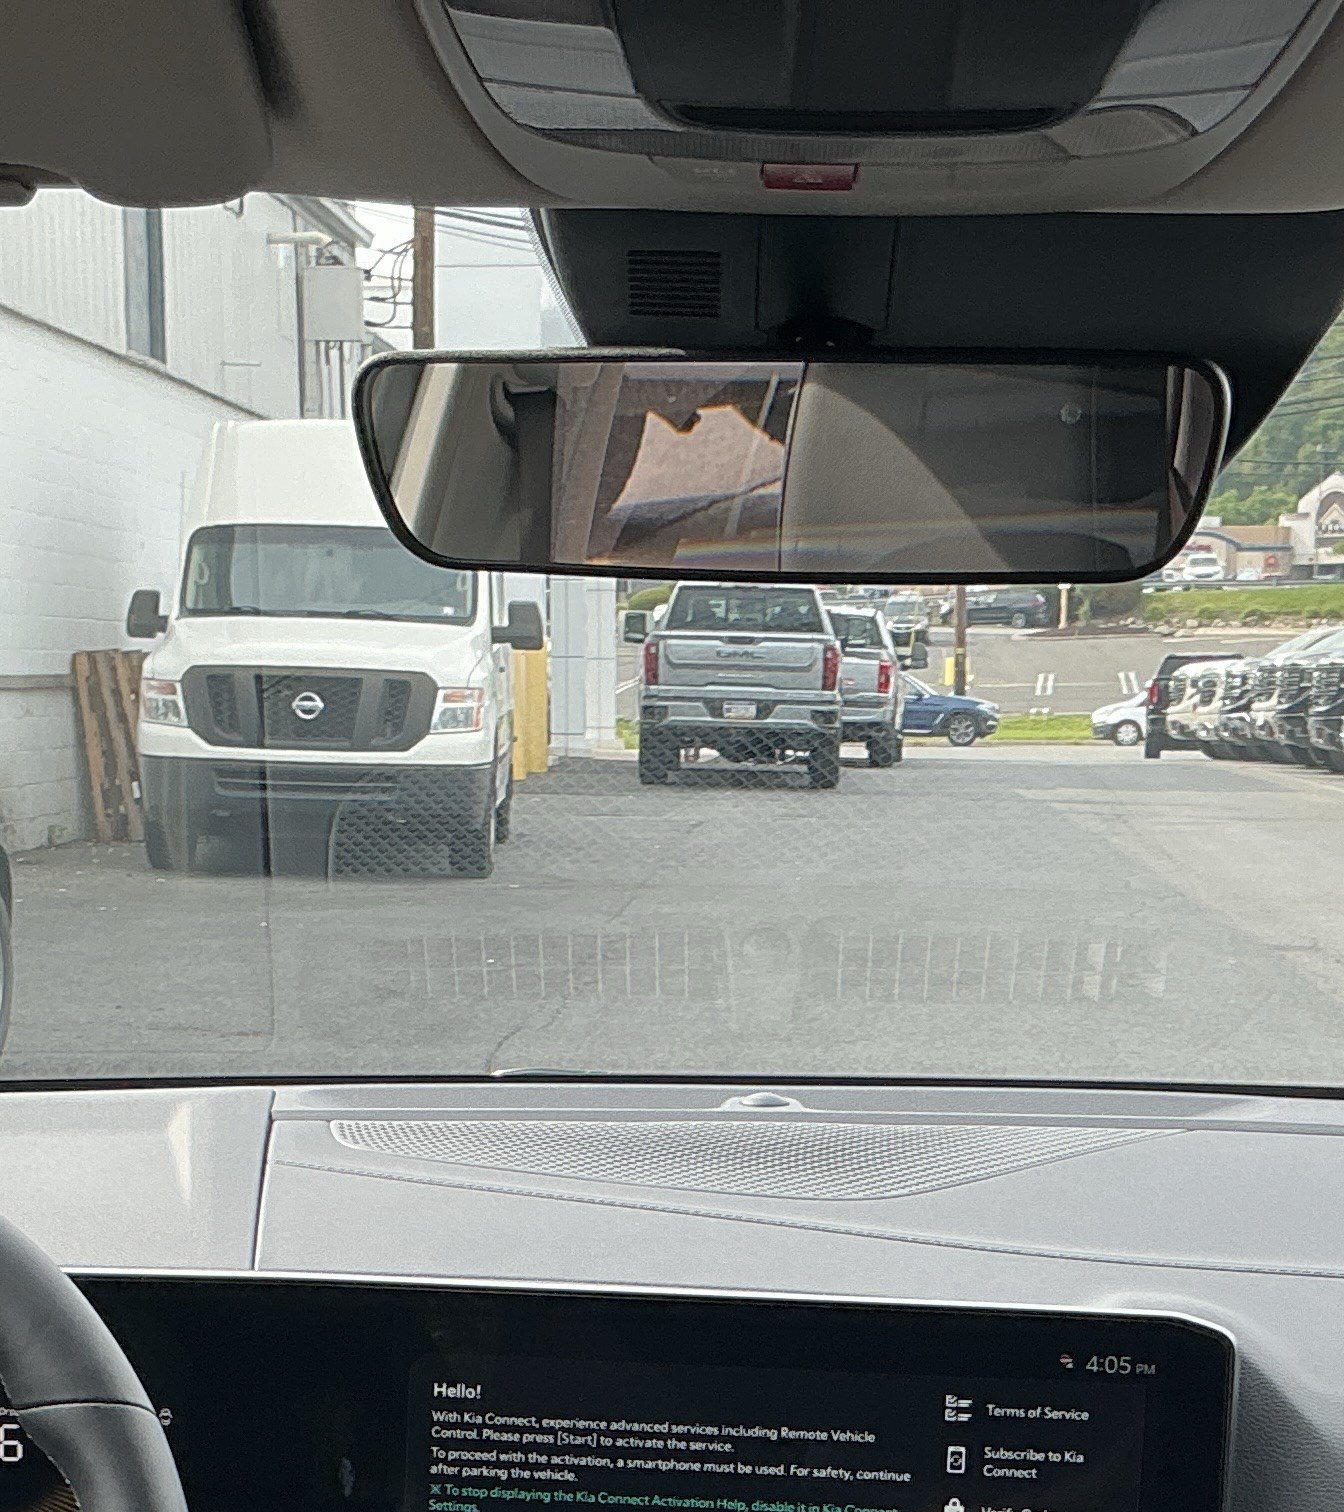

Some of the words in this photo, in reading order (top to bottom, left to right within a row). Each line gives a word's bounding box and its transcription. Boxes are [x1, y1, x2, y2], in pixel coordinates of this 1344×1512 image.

[1085, 1356, 1132, 1374] 4:05
[1136, 1363, 1156, 1374] PM
[433, 1383, 482, 1399] Hello!
[986, 1404, 1025, 1418] Terms
[1027, 1406, 1042, 1419] of
[1043, 1407, 1090, 1421] Service
[431, 1410, 461, 1423] With
[463, 1411, 482, 1424] Kia
[485, 1413, 540, 1428] Connect,
[542, 1416, 607, 1431] experience
[610, 1420, 668, 1433] advanced
[670, 1423, 719, 1436] services
[721, 1425, 778, 1440] including
[780, 1427, 829, 1440] Remote
[831, 1429, 876, 1443] Vehicle
[482, 1428, 521, 1442] Please
[522, 1433, 554, 1446] press
[557, 1431, 598, 1447] [Start]
[600, 1435, 613, 1447] to
[615, 1436, 665, 1449] activate
[666, 1437, 687, 1450] the
[689, 1439, 735, 1453] service.
[983, 1447, 1046, 1462] Subscribe
[1048, 1451, 1061, 1462] to
[1064, 1450, 1085, 1463] Kia
[429, 1464, 460, 1476] after
[461, 1466, 507, 1481] parking
[510, 1467, 531, 1479] the
[533, 1468, 579, 1482] vehicle.
[430, 1447, 446, 1459] To
[447, 1449, 497, 1463] proceed
[499, 1450, 525, 1463] with
[528, 1452, 548, 1464] the
[550, 1453, 614, 1468] activation,
[616, 1458, 625, 1468] a
[626, 1457, 701, 1474] smartphone
[703, 1461, 735, 1474] must
[737, 1462, 753, 1475] be
[755, 1463, 787, 1477] used.
[790, 1465, 809, 1477] For
[812, 1466, 854, 1481] safety,
[856, 1468, 912, 1482] continue
[983, 1464, 1038, 1479] Connect
[444, 1484, 459, 1496] To
[461, 1486, 488, 1499] stop
[490, 1486, 551, 1503] displaying
[553, 1488, 573, 1501] the
[576, 1490, 595, 1503] Kia
[598, 1492, 650, 1506] Connect
[651, 1494, 714, 1509] Activation
[716, 1498, 749, 1512] Help,
[751, 1500, 795, 1512] disable
